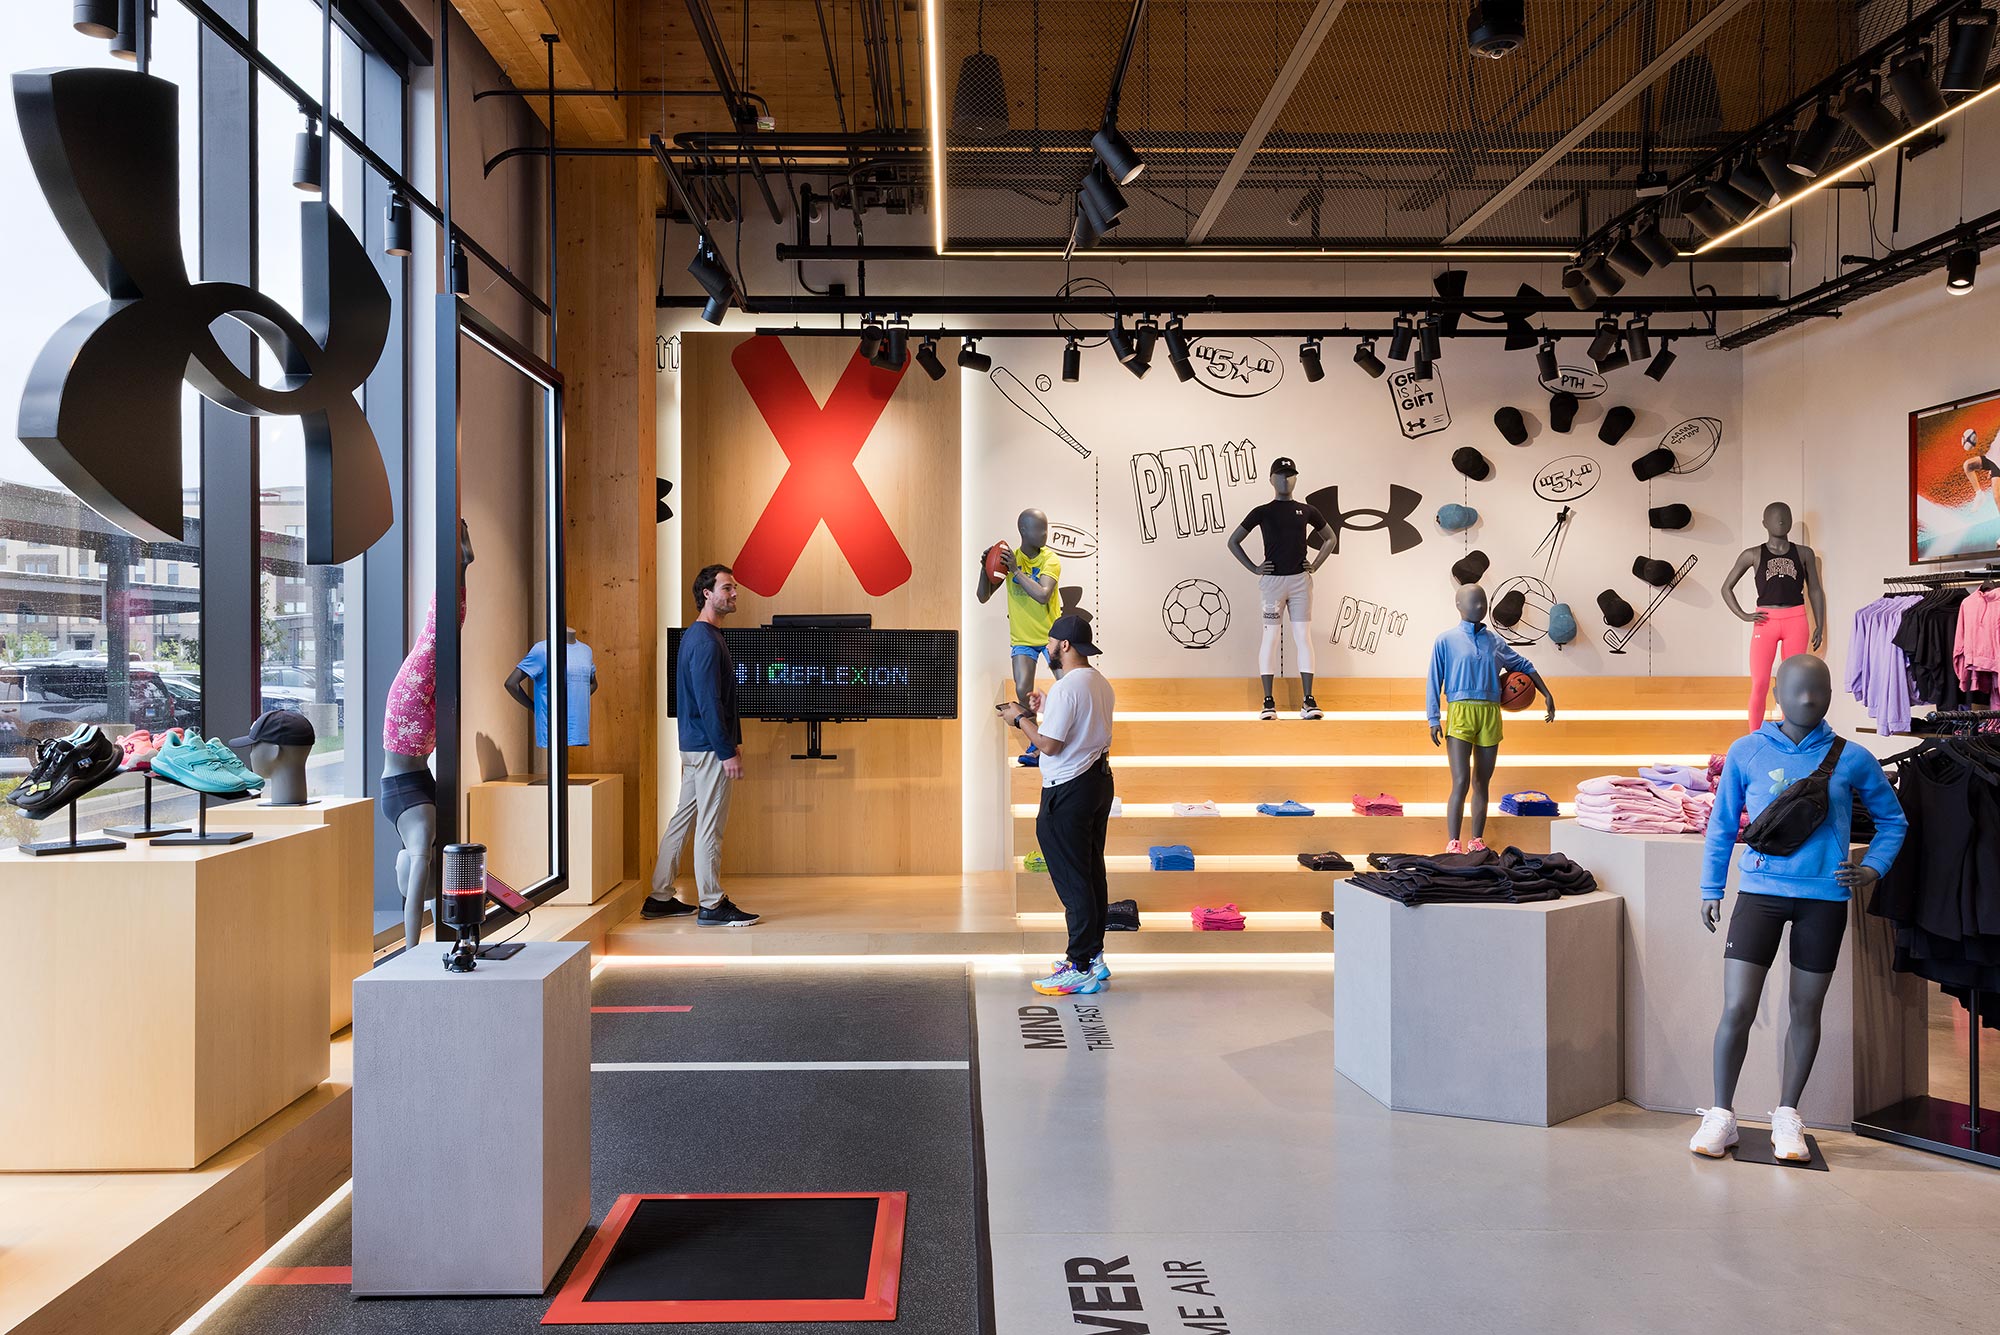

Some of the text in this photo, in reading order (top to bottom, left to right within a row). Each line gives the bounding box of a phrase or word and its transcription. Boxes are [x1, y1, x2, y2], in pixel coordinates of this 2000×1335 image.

[1394, 372, 1416, 387] GR
[1397, 384, 1424, 399] IS A
[1561, 374, 1585, 389] PTH
[1402, 392, 1434, 411] GIFT
[732, 335, 913, 597] X
[1130, 444, 1226, 544] PTH
[1052, 531, 1077, 548] PTH
[1329, 595, 1387, 656] PTH
[1017, 1005, 1068, 1049] MIND
[1073, 1003, 1115, 1051] THINK FAST
[1162, 1260, 1216, 1297] AIR
